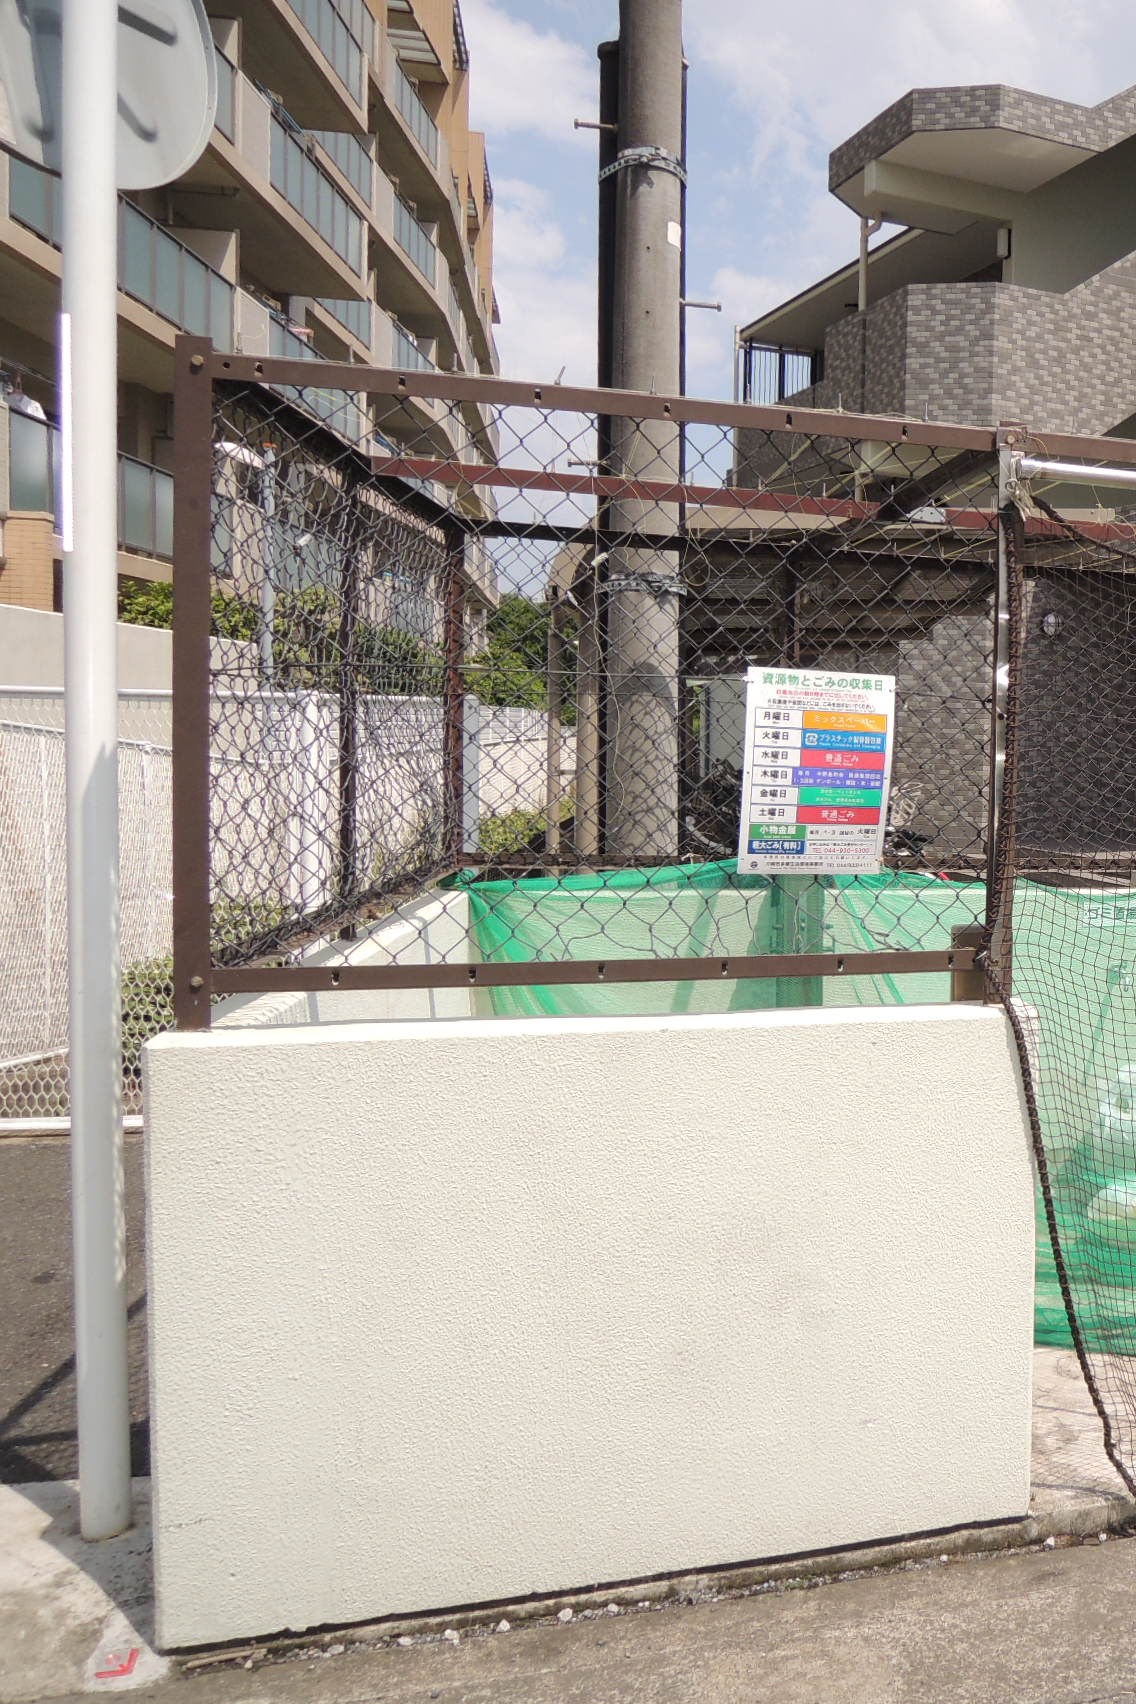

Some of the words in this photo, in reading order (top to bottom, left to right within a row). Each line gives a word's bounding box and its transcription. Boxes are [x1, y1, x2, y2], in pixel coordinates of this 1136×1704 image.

[762, 673, 883, 690] 資源物とごみの収集日
[763, 711, 790, 721] 月曜日
[762, 731, 789, 740] 火曜日
[761, 751, 788, 760] 水曜日
[825, 752, 859, 763] 普通ごみ
[760, 769, 788, 779] 木曜日
[759, 788, 787, 798] 金曜日
[758, 807, 785, 817] 土曜日
[821, 809, 855, 819] 普通ごみ
[759, 825, 796, 835] 小物金属
[857, 828, 877, 836] 火曜日
